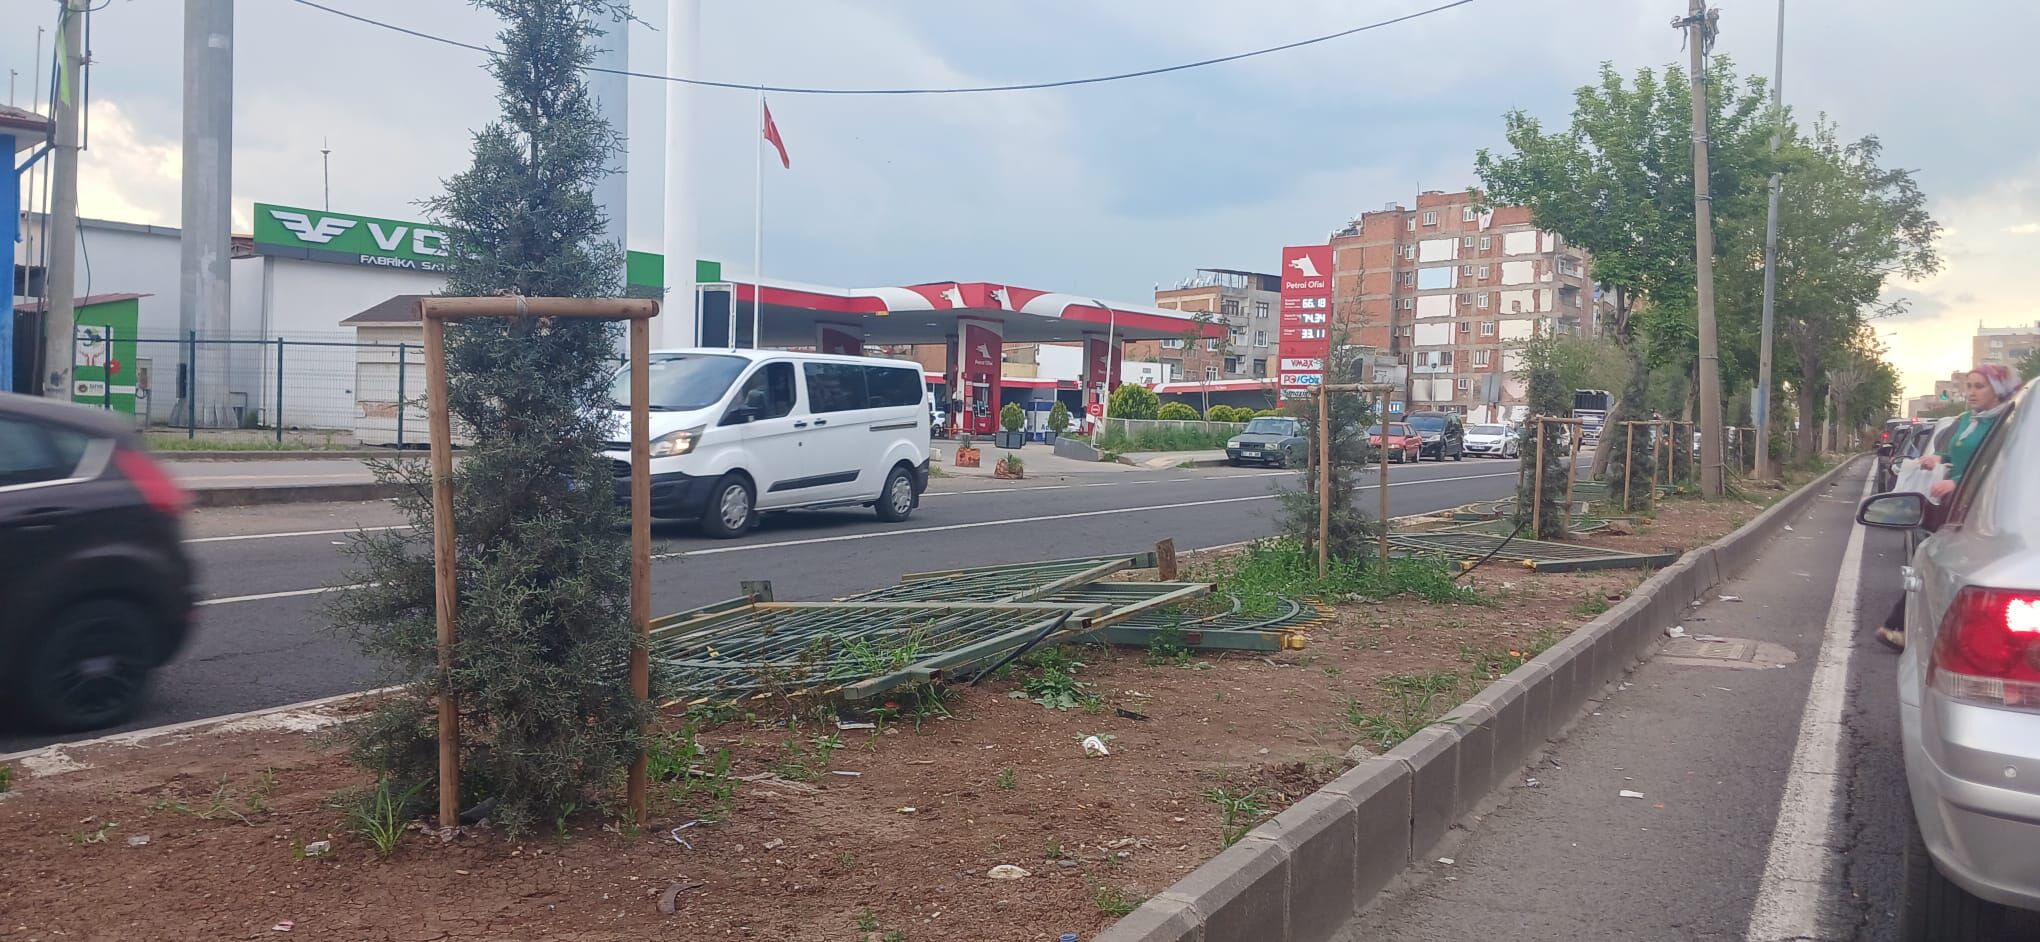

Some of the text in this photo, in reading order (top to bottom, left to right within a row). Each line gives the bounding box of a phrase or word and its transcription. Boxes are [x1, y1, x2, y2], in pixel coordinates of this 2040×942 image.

[360, 254, 416, 269] FABRİKA
[1286, 280, 1325, 289] Petrol Ofisi
